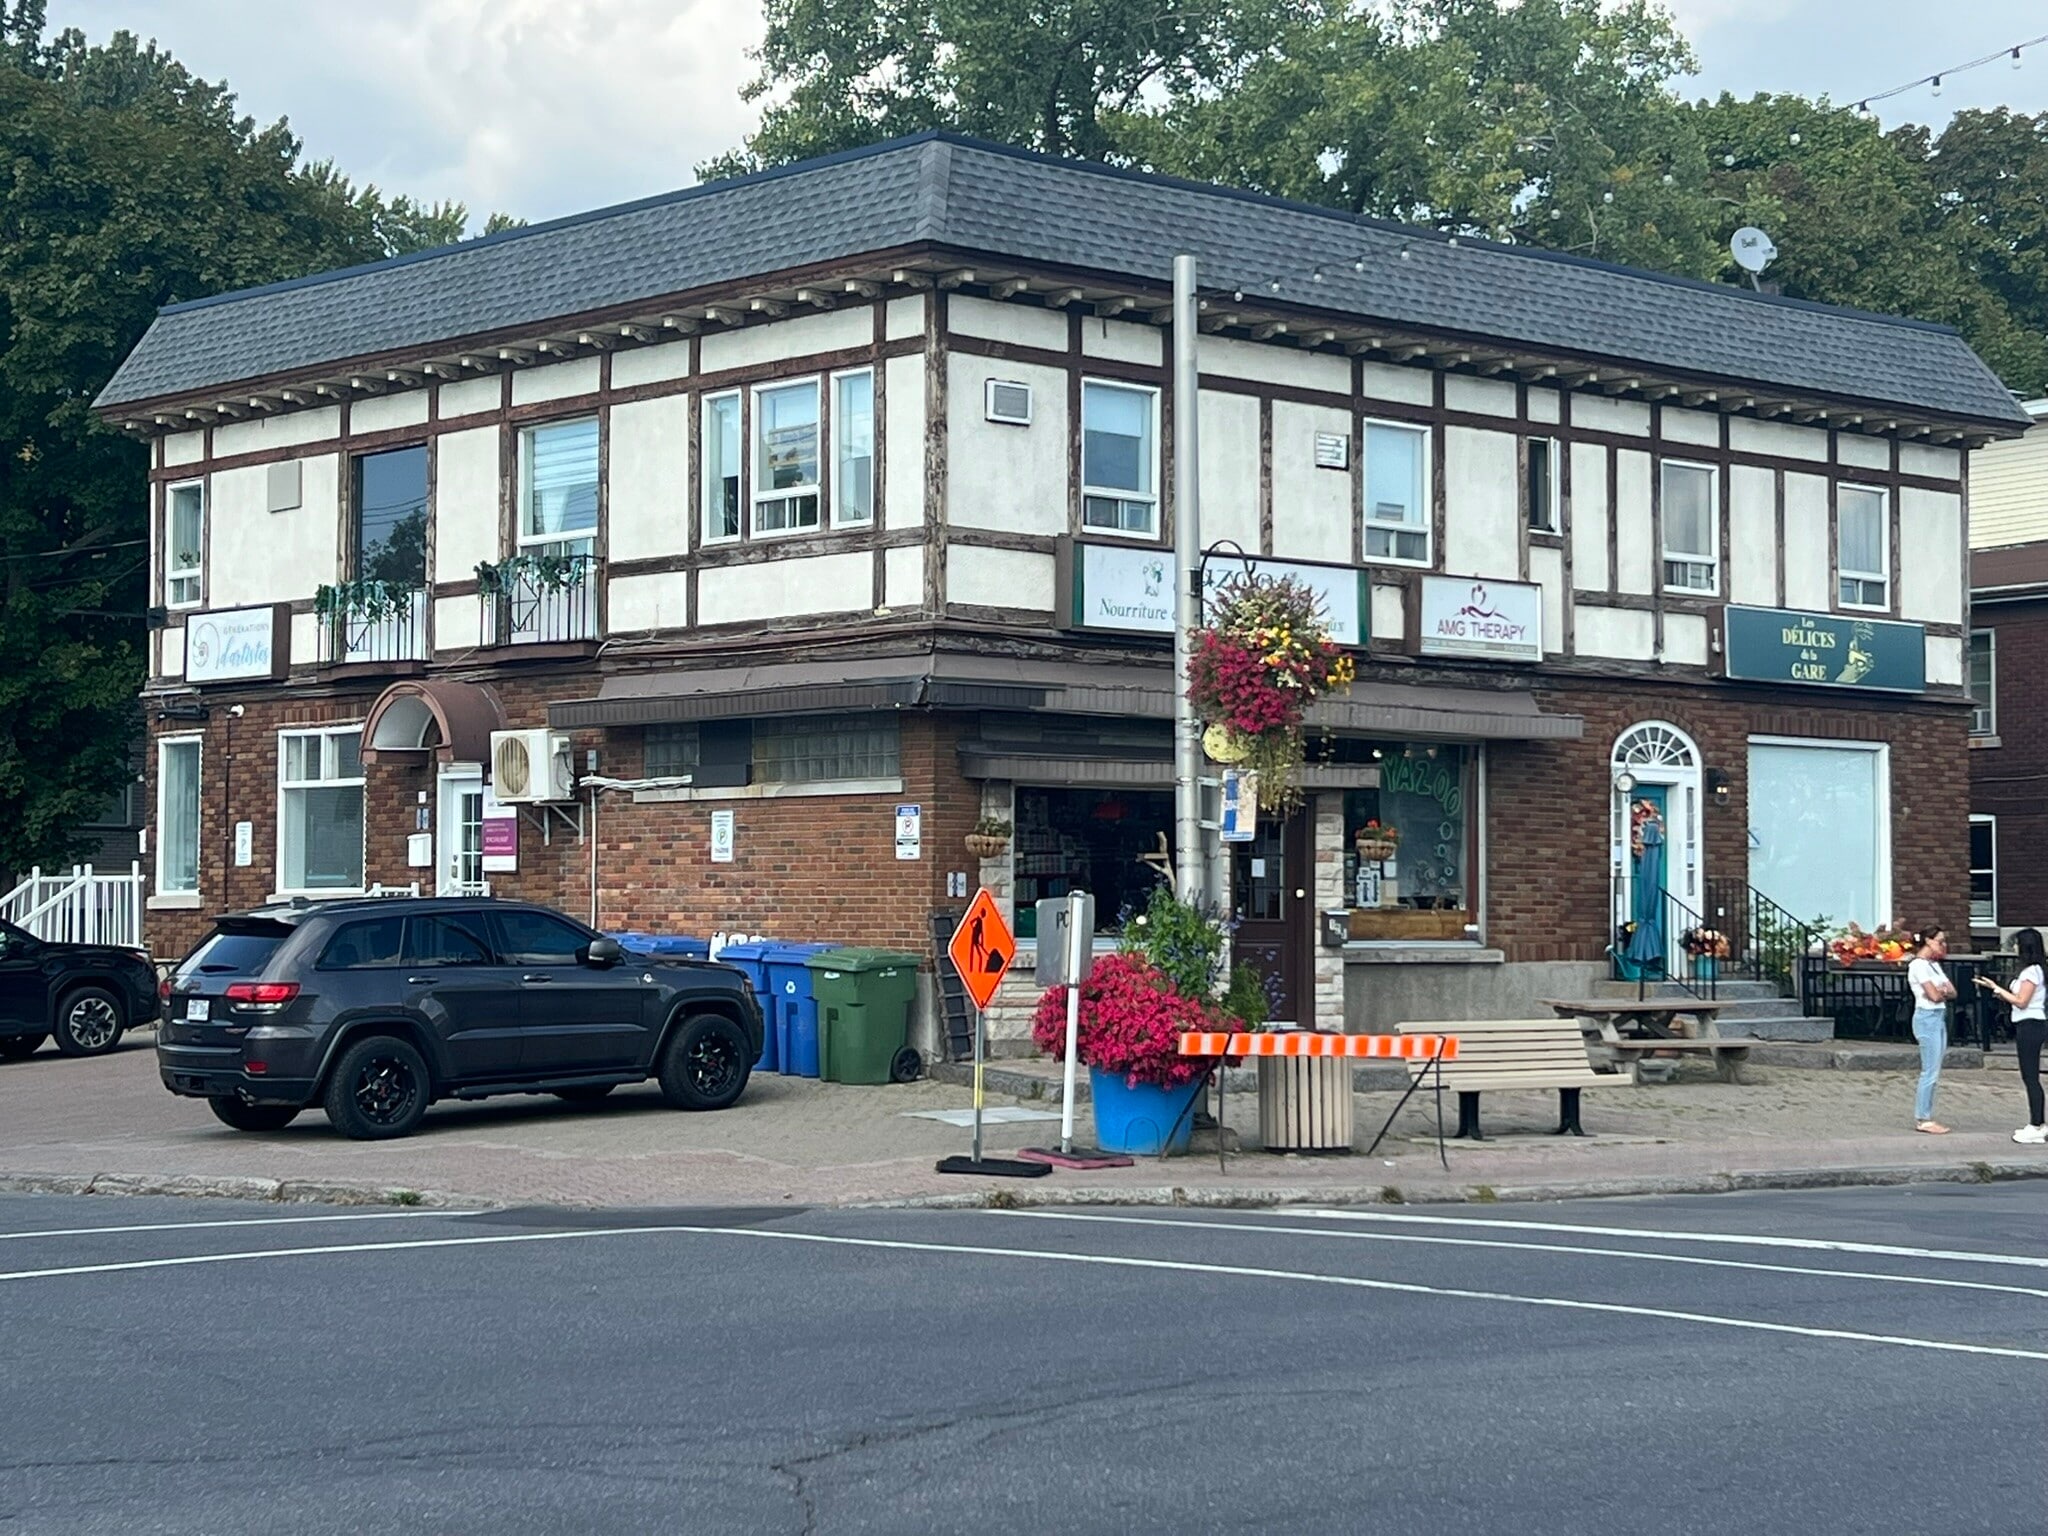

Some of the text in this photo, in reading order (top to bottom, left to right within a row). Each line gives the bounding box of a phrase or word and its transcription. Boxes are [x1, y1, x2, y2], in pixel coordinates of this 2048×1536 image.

[1099, 598, 1168, 620] Nourriture
[1437, 620, 1526, 641] AMG THERAPY
[1802, 617, 1815, 628] Les
[1782, 624, 1836, 649] DÉLICES
[1791, 662, 1827, 681] GARE
